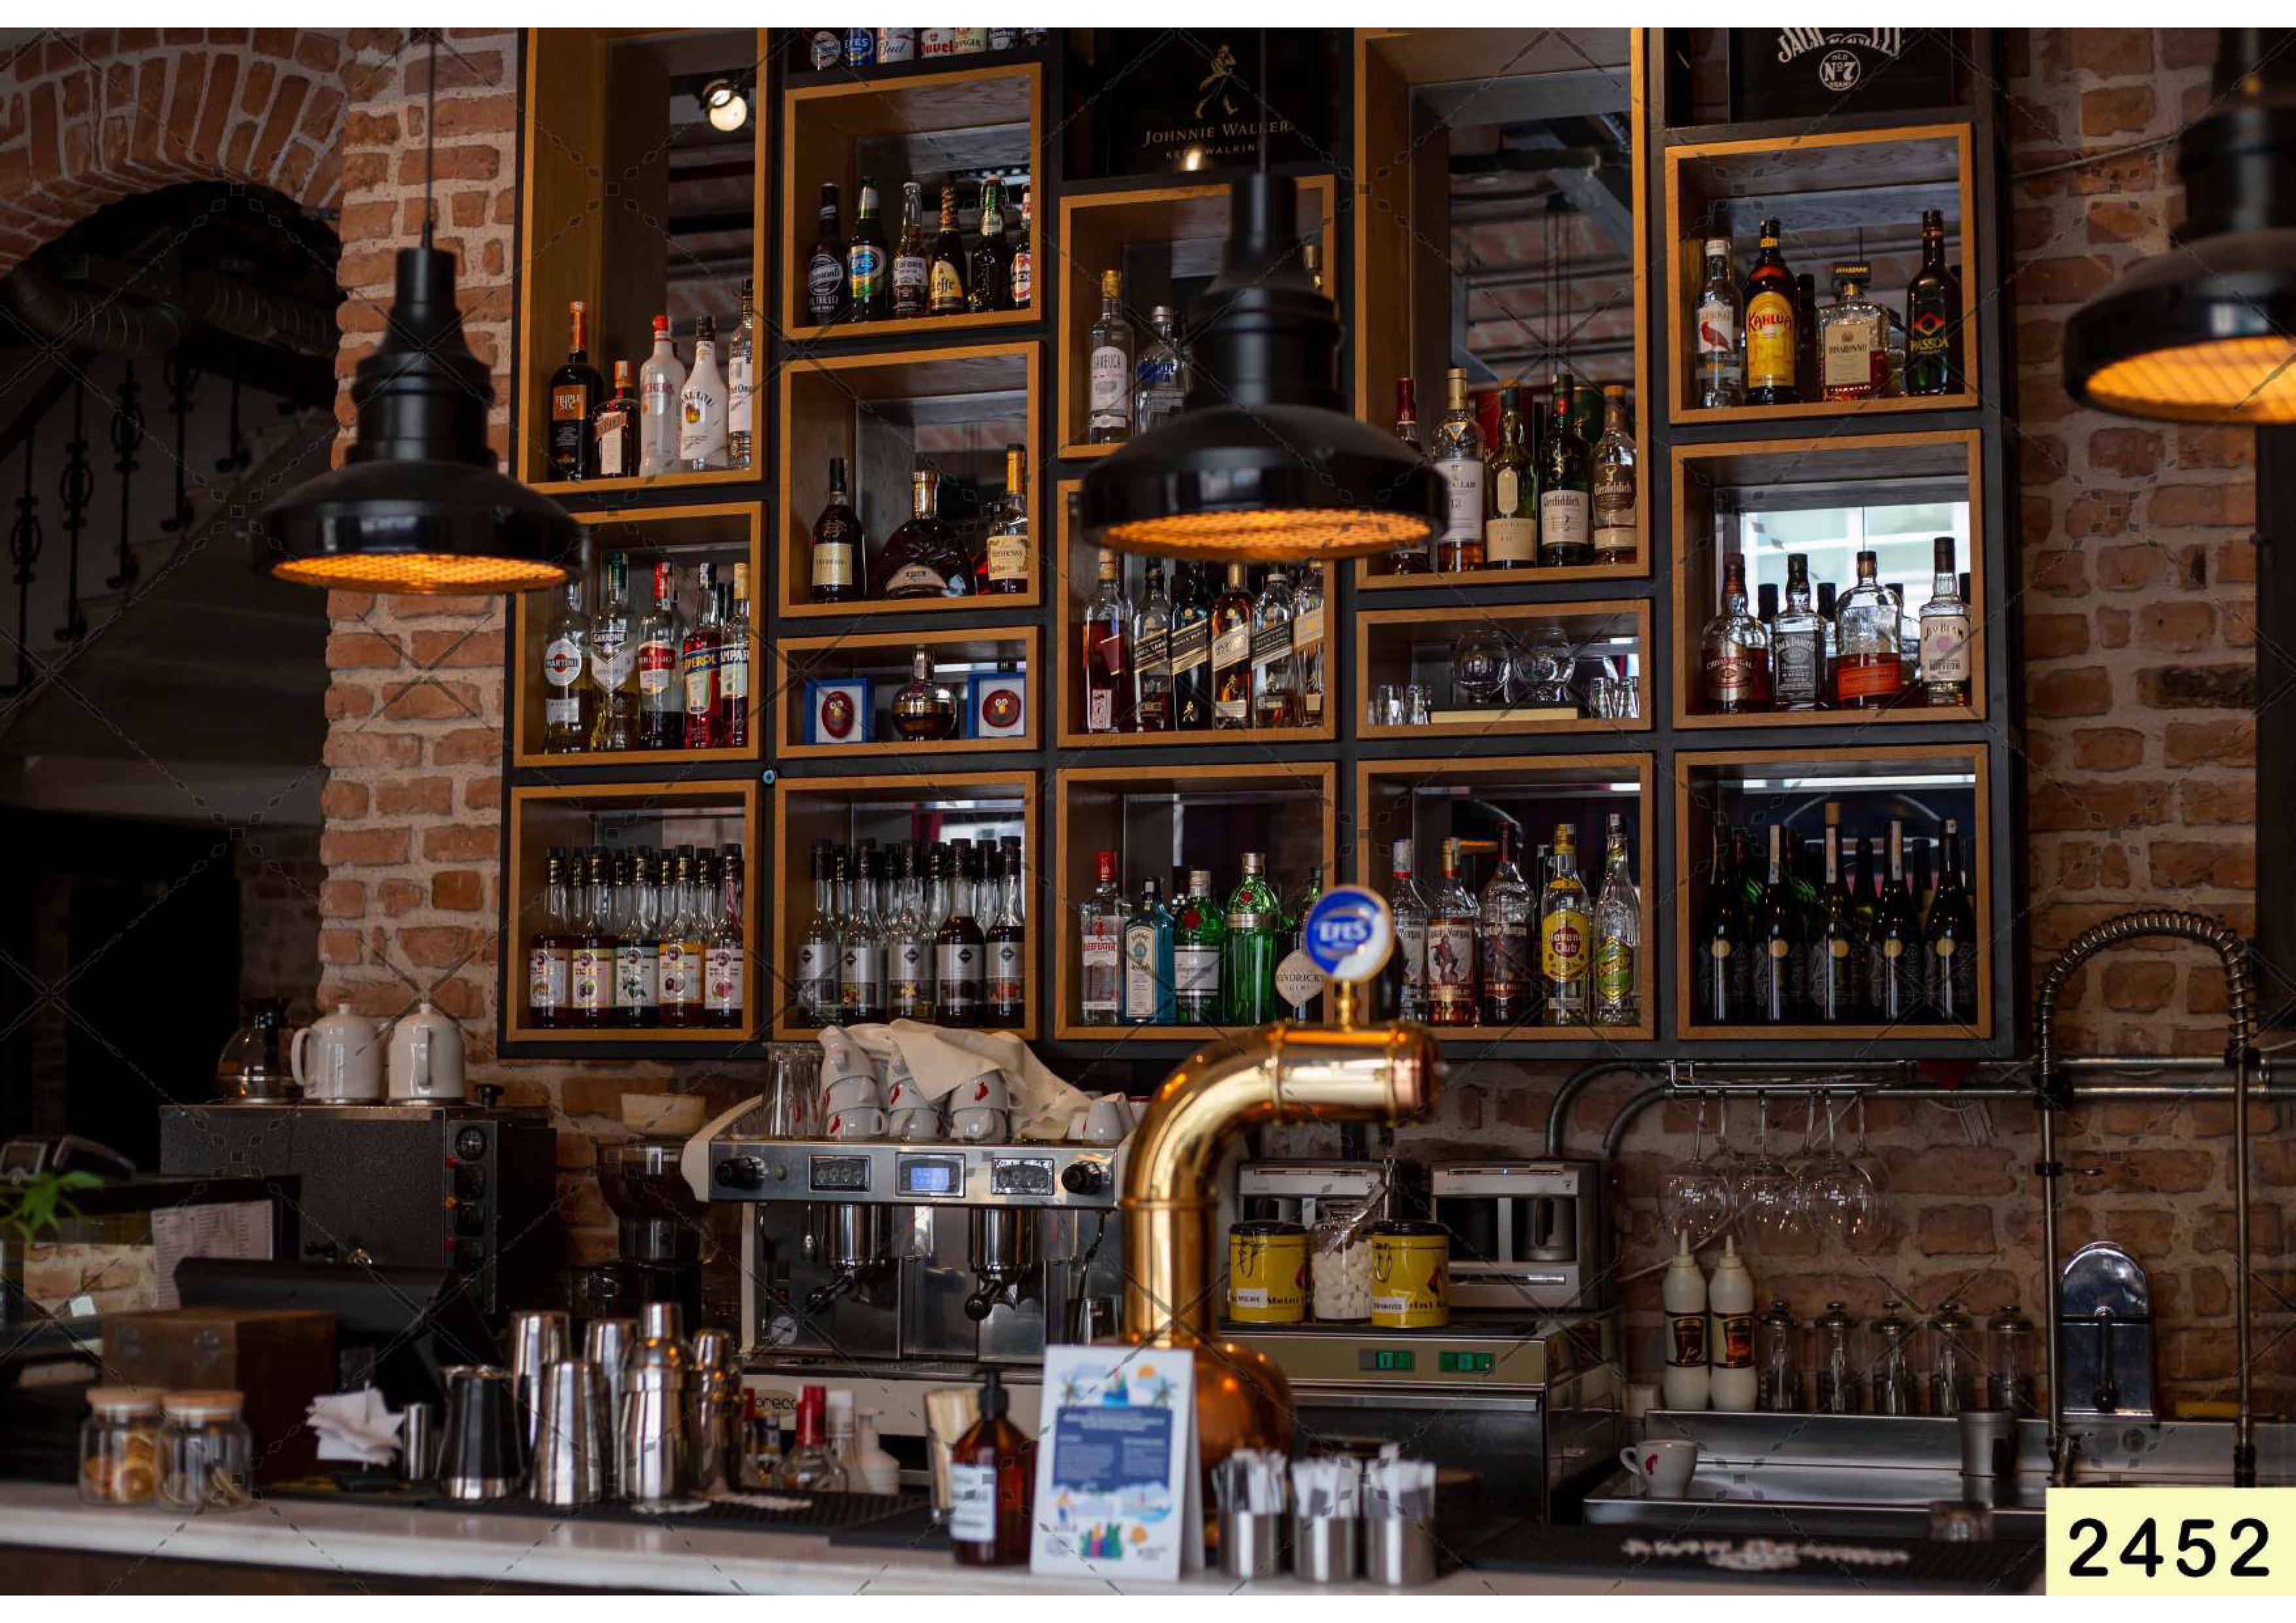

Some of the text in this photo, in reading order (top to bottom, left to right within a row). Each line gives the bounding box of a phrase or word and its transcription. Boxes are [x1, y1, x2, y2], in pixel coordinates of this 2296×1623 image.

[1142, 120, 1290, 148] JOHNNIE WALKER
[1205, 143, 1256, 156] WALKIN
